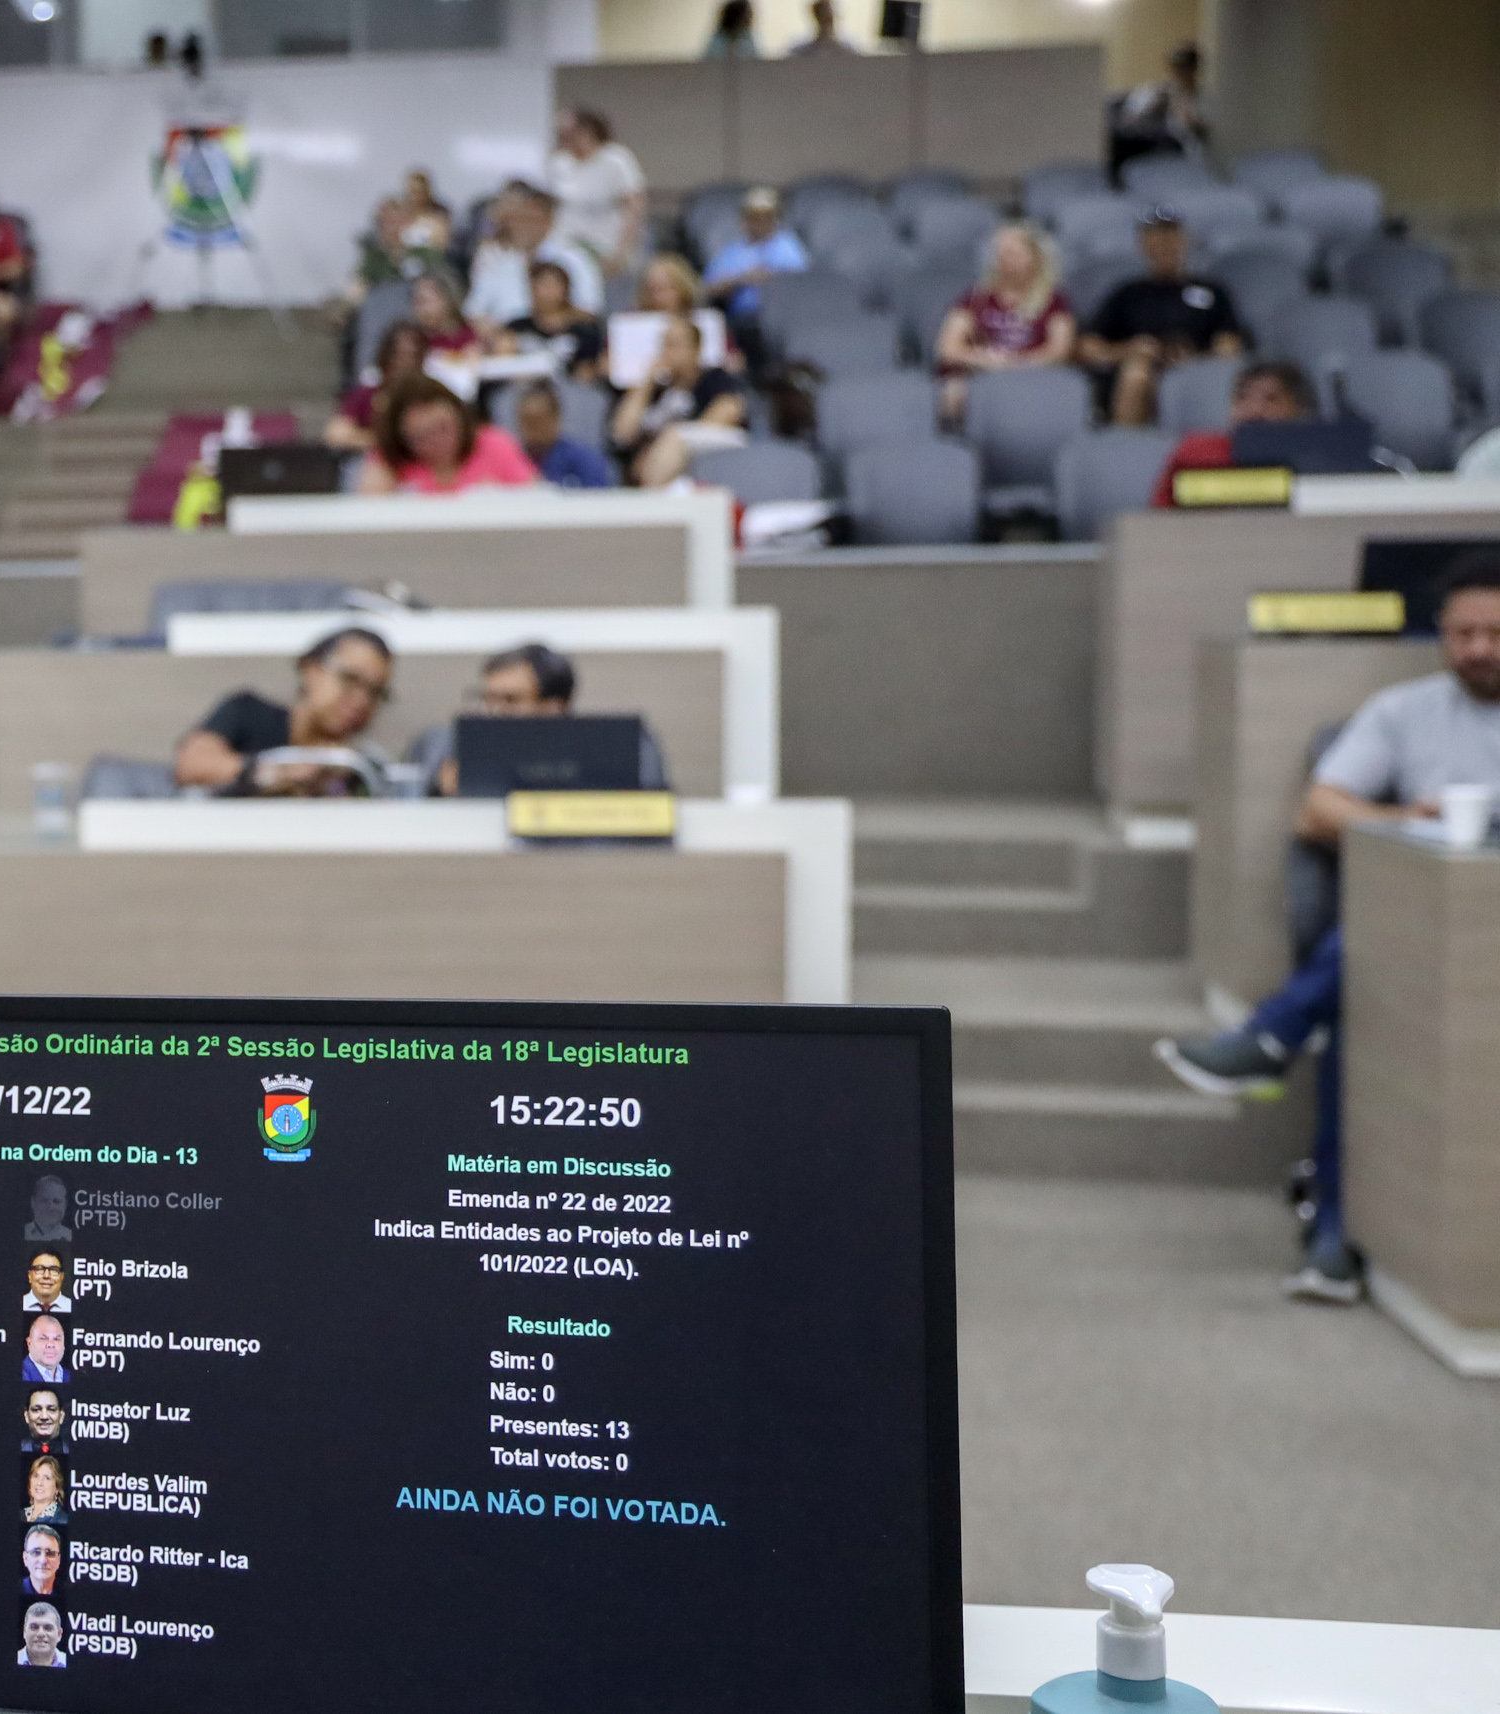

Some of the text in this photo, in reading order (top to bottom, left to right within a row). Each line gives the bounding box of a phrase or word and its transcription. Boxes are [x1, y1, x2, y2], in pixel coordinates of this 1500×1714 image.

[46, 1034, 153, 1055] Ordinária
[162, 1036, 189, 1055] da
[228, 1037, 314, 1057] Sessão
[324, 1038, 454, 1063] Legislativa
[463, 1040, 492, 1060] da
[548, 1041, 688, 1067] Legislatura
[491, 1095, 641, 1127] 15:22:50
[1, 1147, 23, 1160] na
[29, 1144, 91, 1162] Ordem
[97, 1146, 121, 1162] do
[127, 1146, 157, 1163] Dia
[176, 1148, 197, 1164] 13
[448, 1155, 671, 1177] Matéria em Discussão
[75, 1190, 222, 1209] Cristiano Coller
[449, 1189, 529, 1209] Emenda
[562, 1193, 586, 1210] 22
[592, 1194, 617, 1211] de
[623, 1195, 671, 1213] 2022
[75, 1210, 126, 1230] (PTB)
[375, 1219, 434, 1238] Indica
[441, 1221, 541, 1241] Entidades
[546, 1229, 572, 1242] ao
[578, 1226, 652, 1248] Projeto
[658, 1228, 683, 1246] de
[690, 1229, 720, 1247] Lei
[74, 1258, 188, 1279] Enio Brizola
[480, 1254, 638, 1280] 101/2022 (LOA).
[73, 1279, 111, 1301] (PT)
[508, 1316, 610, 1337] Resultado
[72, 1328, 260, 1356] Fernando Lourenço
[72, 1349, 125, 1372] (PDT)
[490, 1351, 553, 1370] Sim: 0
[490, 1382, 555, 1402] Não: 0
[72, 1399, 190, 1424] Inspetor Luz
[71, 1420, 130, 1443] (MDB)
[490, 1415, 629, 1439] Presentes: 13
[490, 1447, 628, 1471] Total votos: 0
[71, 1470, 207, 1494] Lourdes Valim
[70, 1490, 200, 1518] (REPUBLICA)
[396, 1487, 725, 1526] AINDA NÃO FOI VOTADA.
[70, 1541, 144, 1563] Ricardo
[150, 1546, 203, 1566] Ritter
[220, 1550, 248, 1569] Ica
[69, 1562, 138, 1587] (PSDB)
[68, 1612, 214, 1642] Vladi Lourenço
[68, 1634, 137, 1659] (PSDB)
